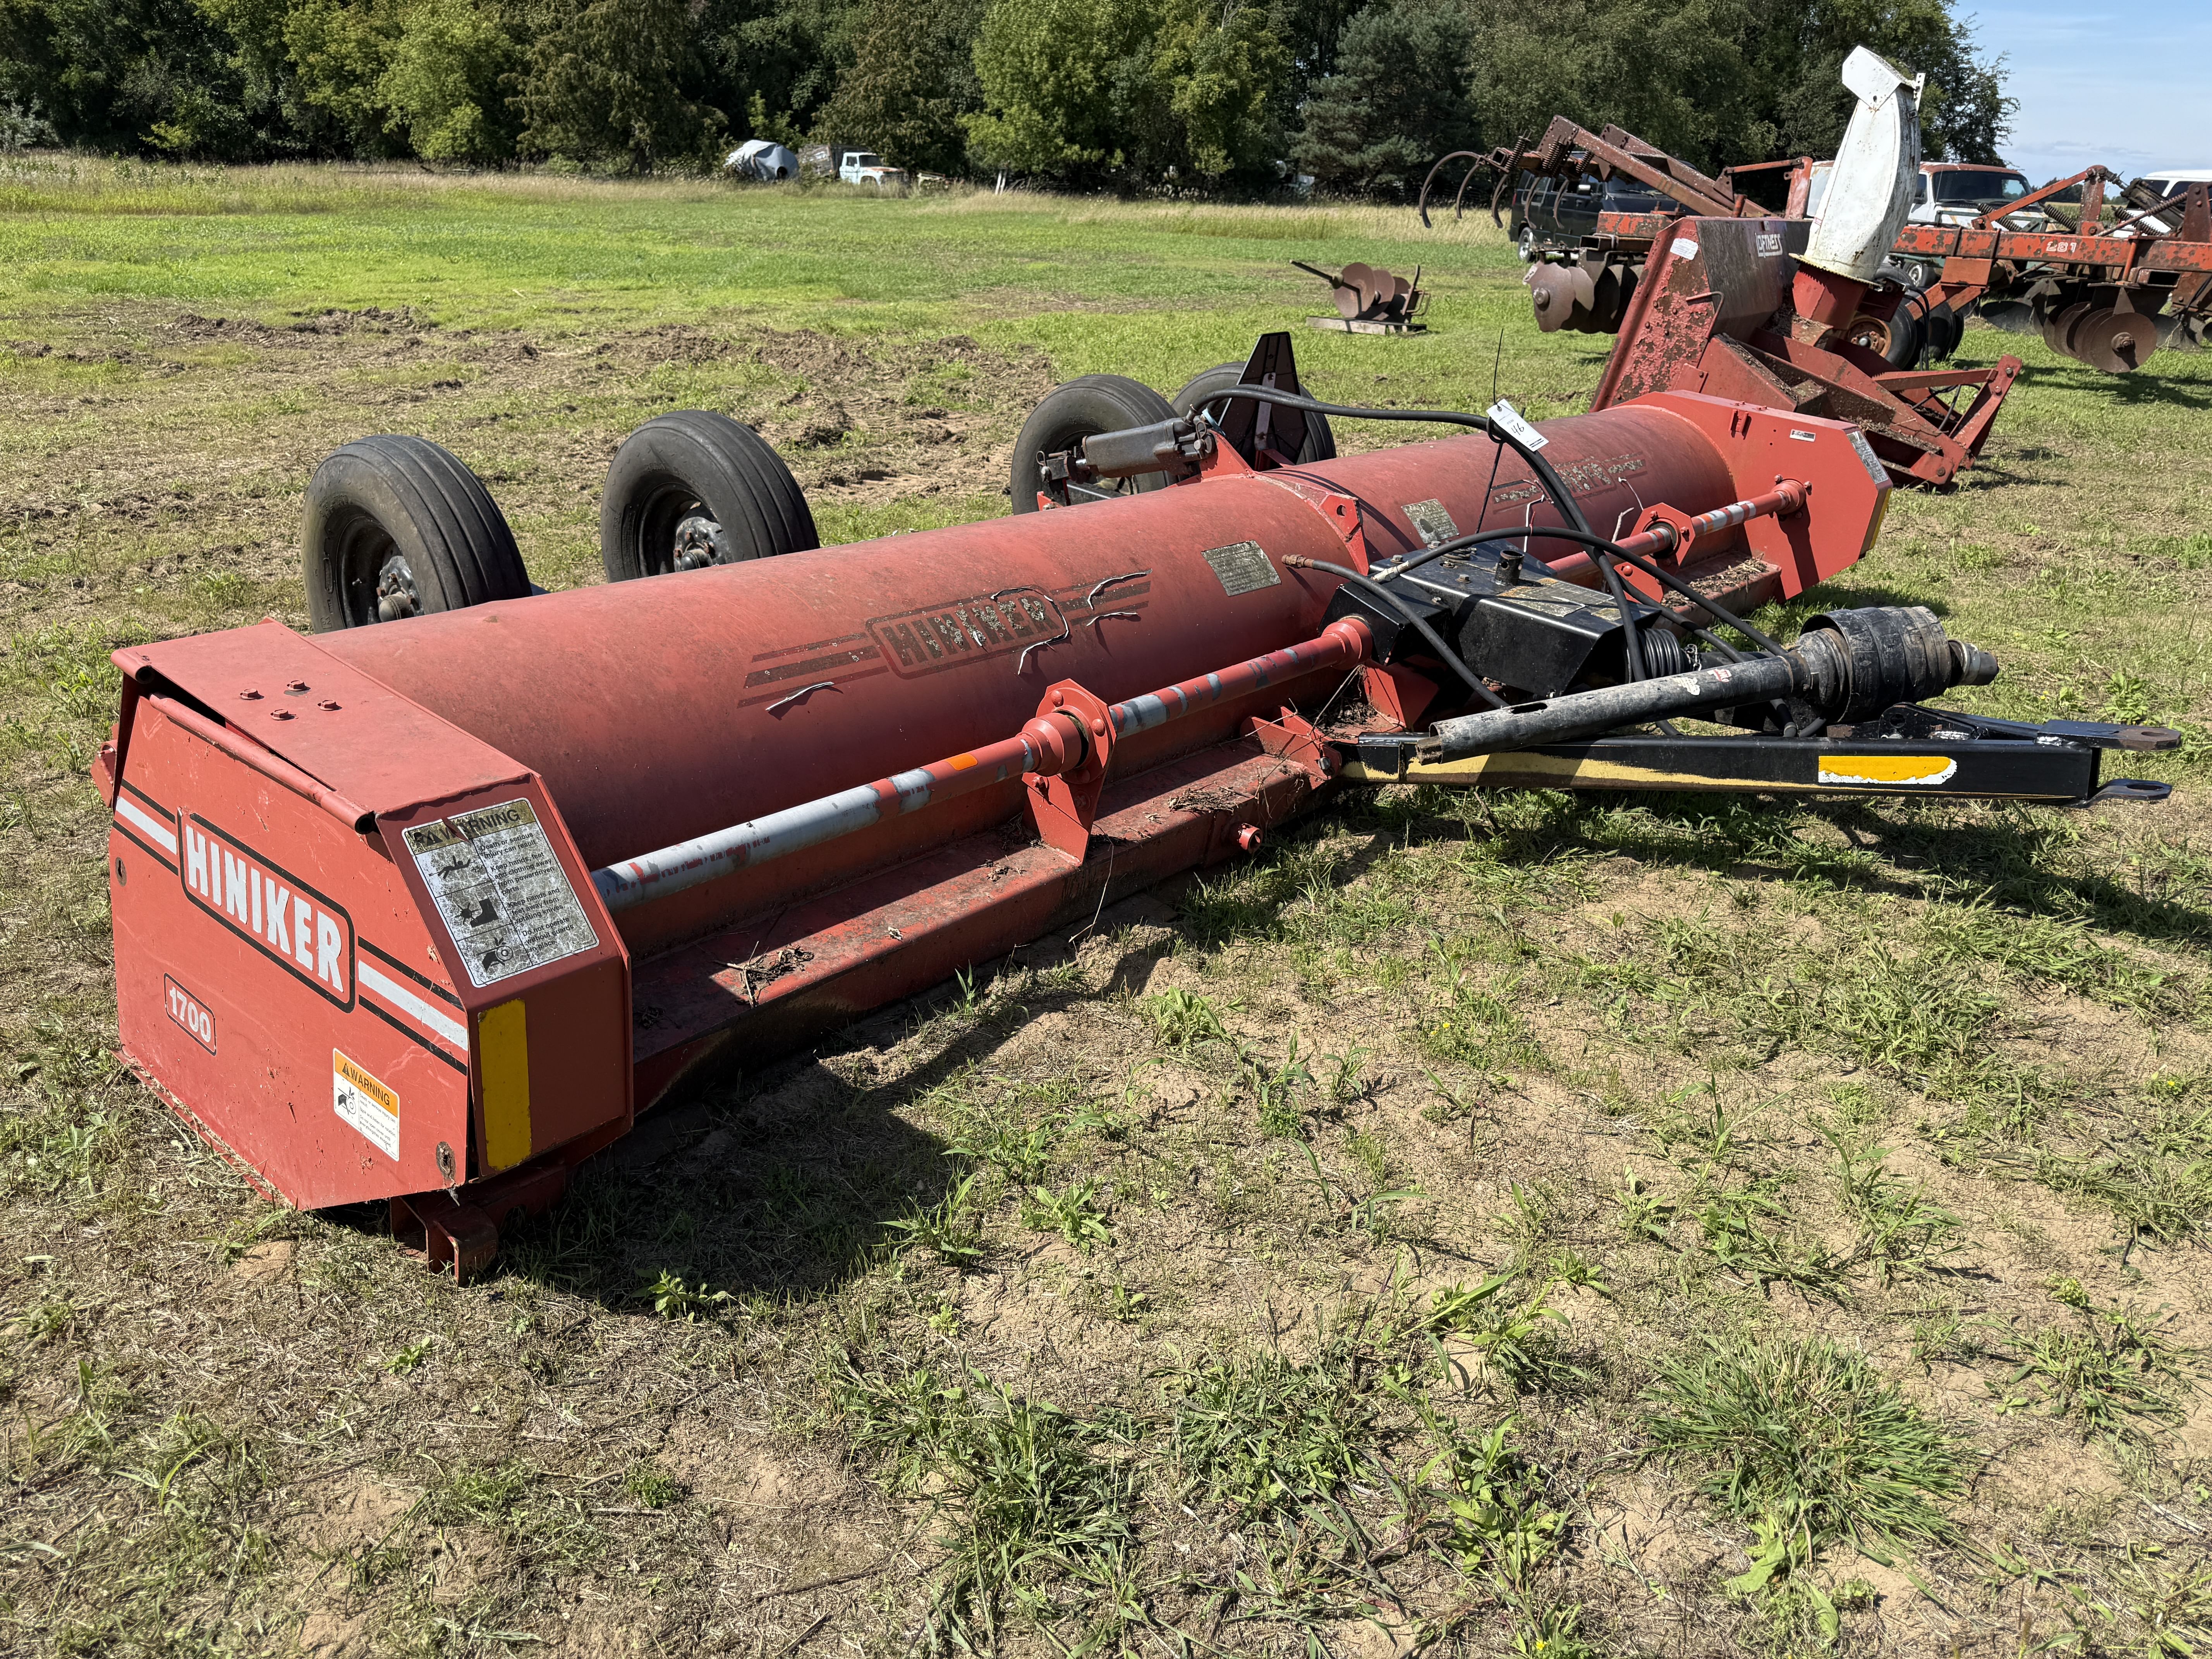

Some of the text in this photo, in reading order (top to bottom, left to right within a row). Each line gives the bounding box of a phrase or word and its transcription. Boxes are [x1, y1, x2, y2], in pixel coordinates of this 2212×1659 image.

[2046, 241, 2077, 253] 281
[1511, 422, 1524, 435] 46
[880, 595, 1060, 666] HINIKER
[481, 842, 500, 852] Death
[509, 833, 534, 843] serious
[490, 862, 508, 872] Keep
[495, 858, 552, 880] and clothing away
[498, 866, 555, 887] from powerdriven
[501, 887, 522, 896] parts.
[508, 899, 526, 908] Keep
[526, 892, 547, 902] hands
[186, 824, 344, 993] HINIKER
[526, 903, 543, 912] away
[543, 897, 559, 905] from
[515, 905, 566, 924] rotating knives.
[526, 924, 574, 945] without guards
[533, 925, 544, 933] not
[545, 917, 570, 930] operate
[169, 986, 211, 1042] 1700
[350, 1067, 390, 1106] WARNING
